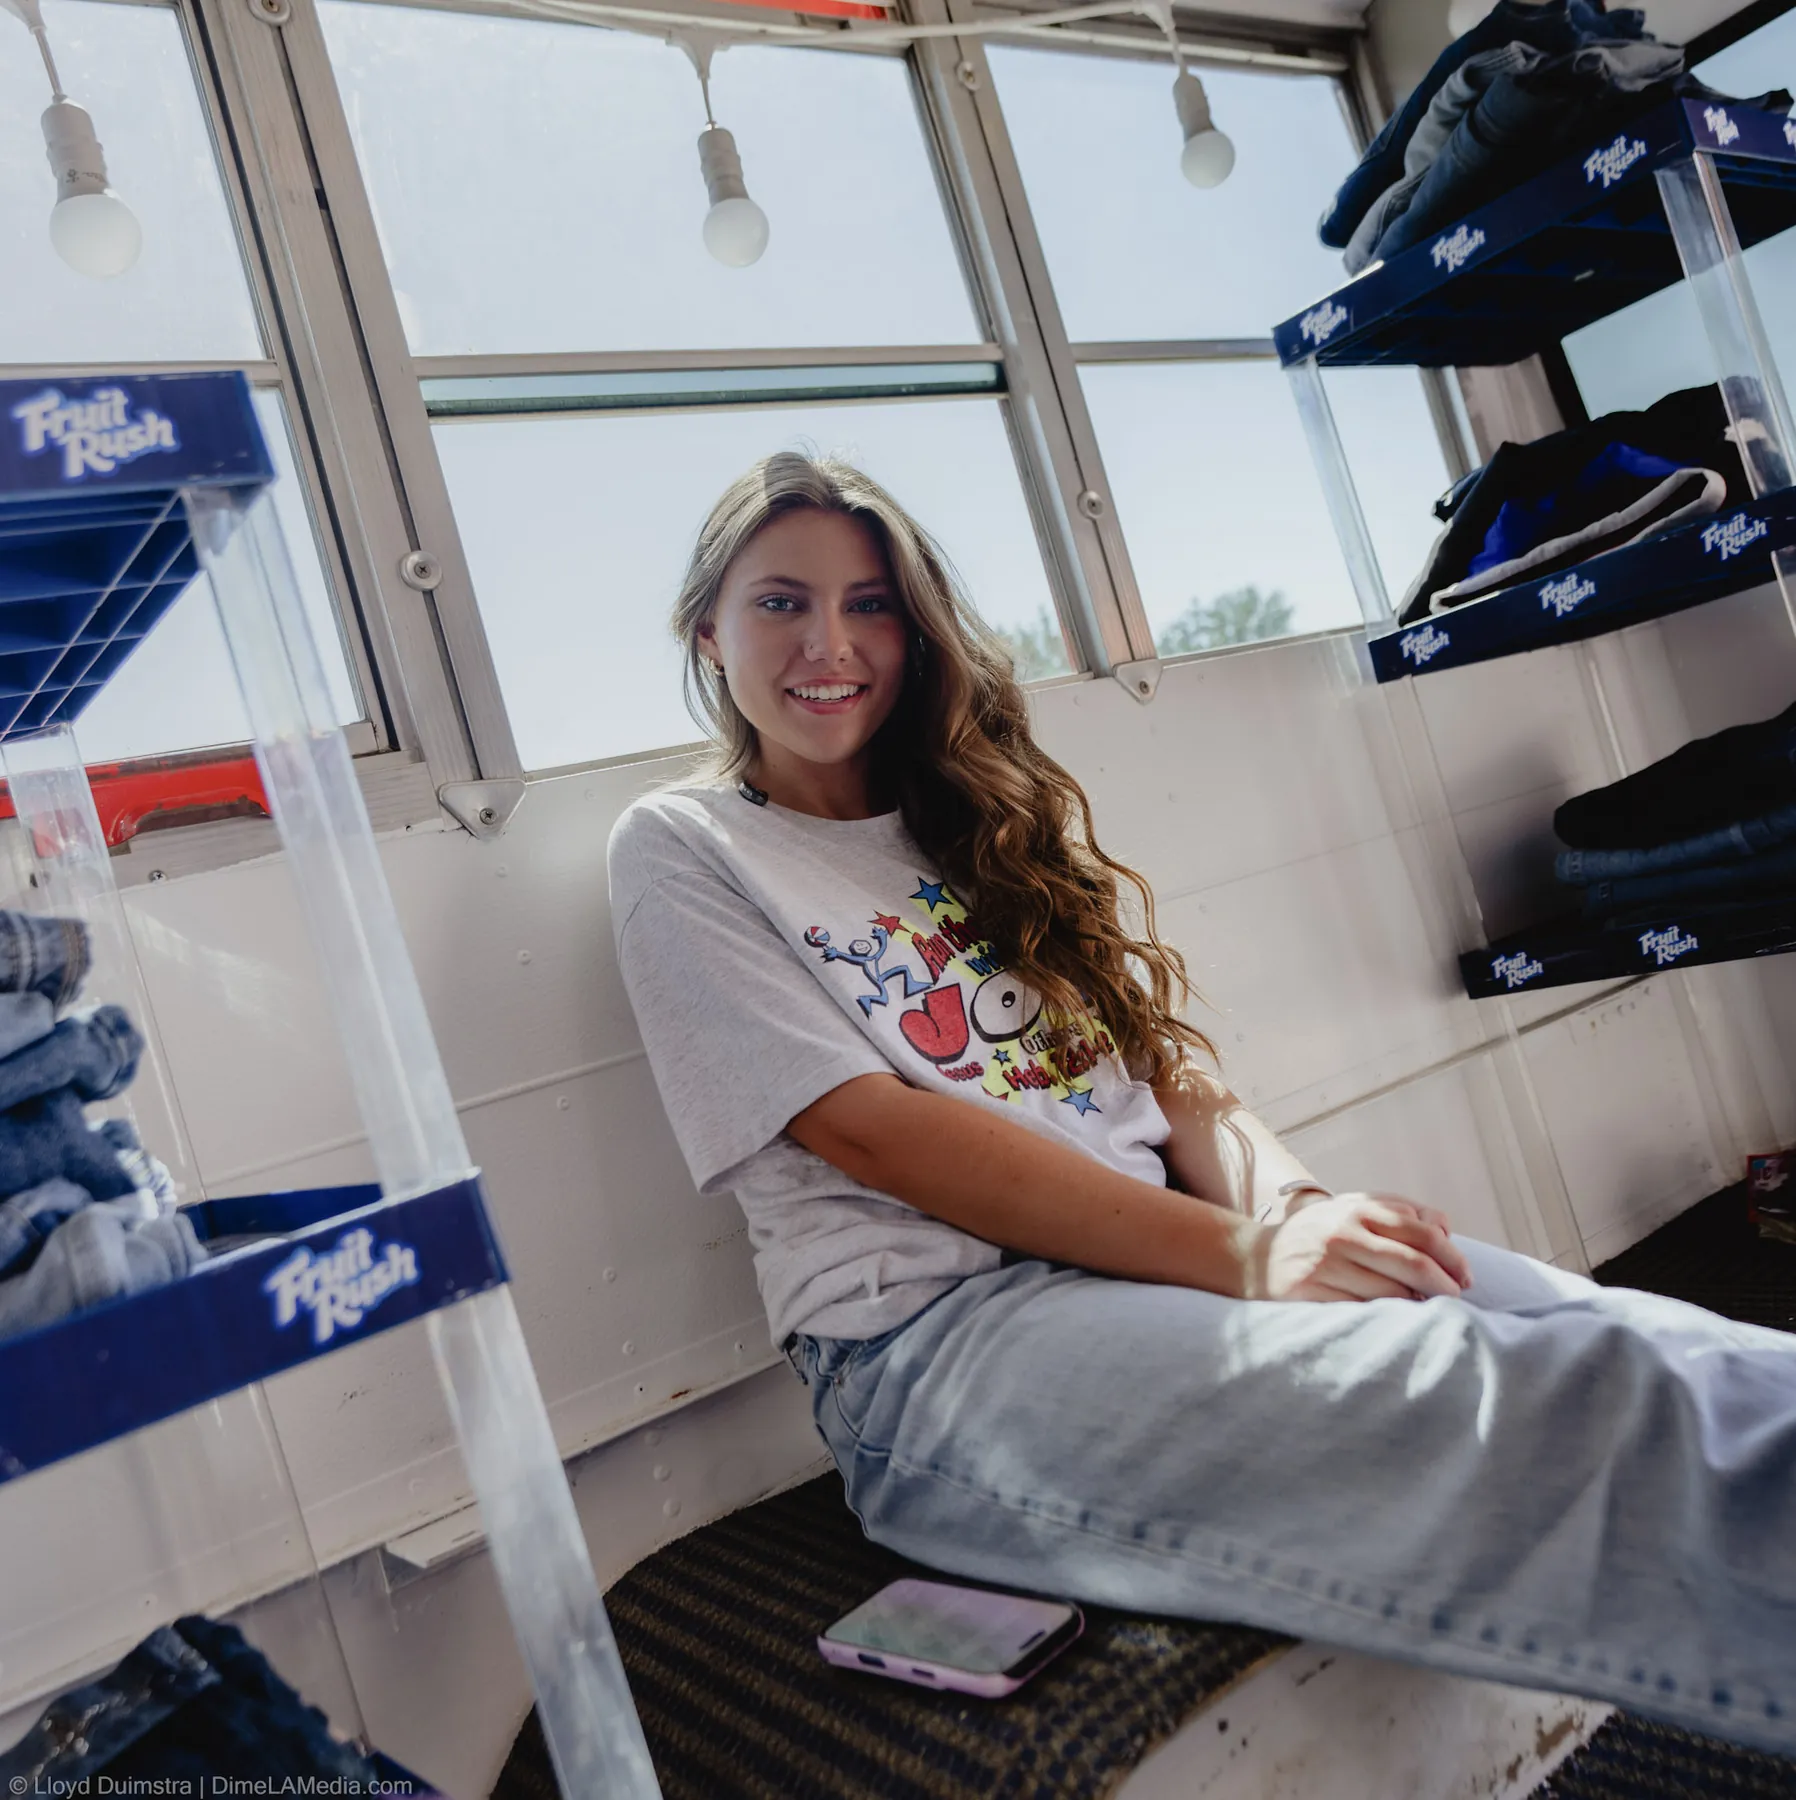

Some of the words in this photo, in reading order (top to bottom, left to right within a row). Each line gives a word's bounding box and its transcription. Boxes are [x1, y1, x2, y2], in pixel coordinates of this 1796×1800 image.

[1583, 135, 1626, 182] Fruit
[1600, 140, 1647, 188] Rush
[1430, 224, 1468, 267] Fruit
[1445, 228, 1485, 273] Rush
[1299, 300, 1332, 340] Fruit
[1311, 305, 1347, 346] Rush
[12, 387, 128, 451] Fruit
[57, 411, 176, 478] Rush
[1700, 513, 1746, 552] Fruit
[1717, 519, 1767, 560] Rush
[1538, 573, 1578, 609] Fruit
[1552, 579, 1596, 617] Rush
[1400, 625, 1433, 658] Fruit
[1413, 631, 1449, 665] Rush
[1638, 925, 1679, 955] Fruit
[1653, 934, 1698, 964] Rush
[1491, 952, 1527, 978] Fruit
[1504, 960, 1543, 987] Rush
[264, 1228, 374, 1326] Fruit
[308, 1243, 418, 1342] Rush
